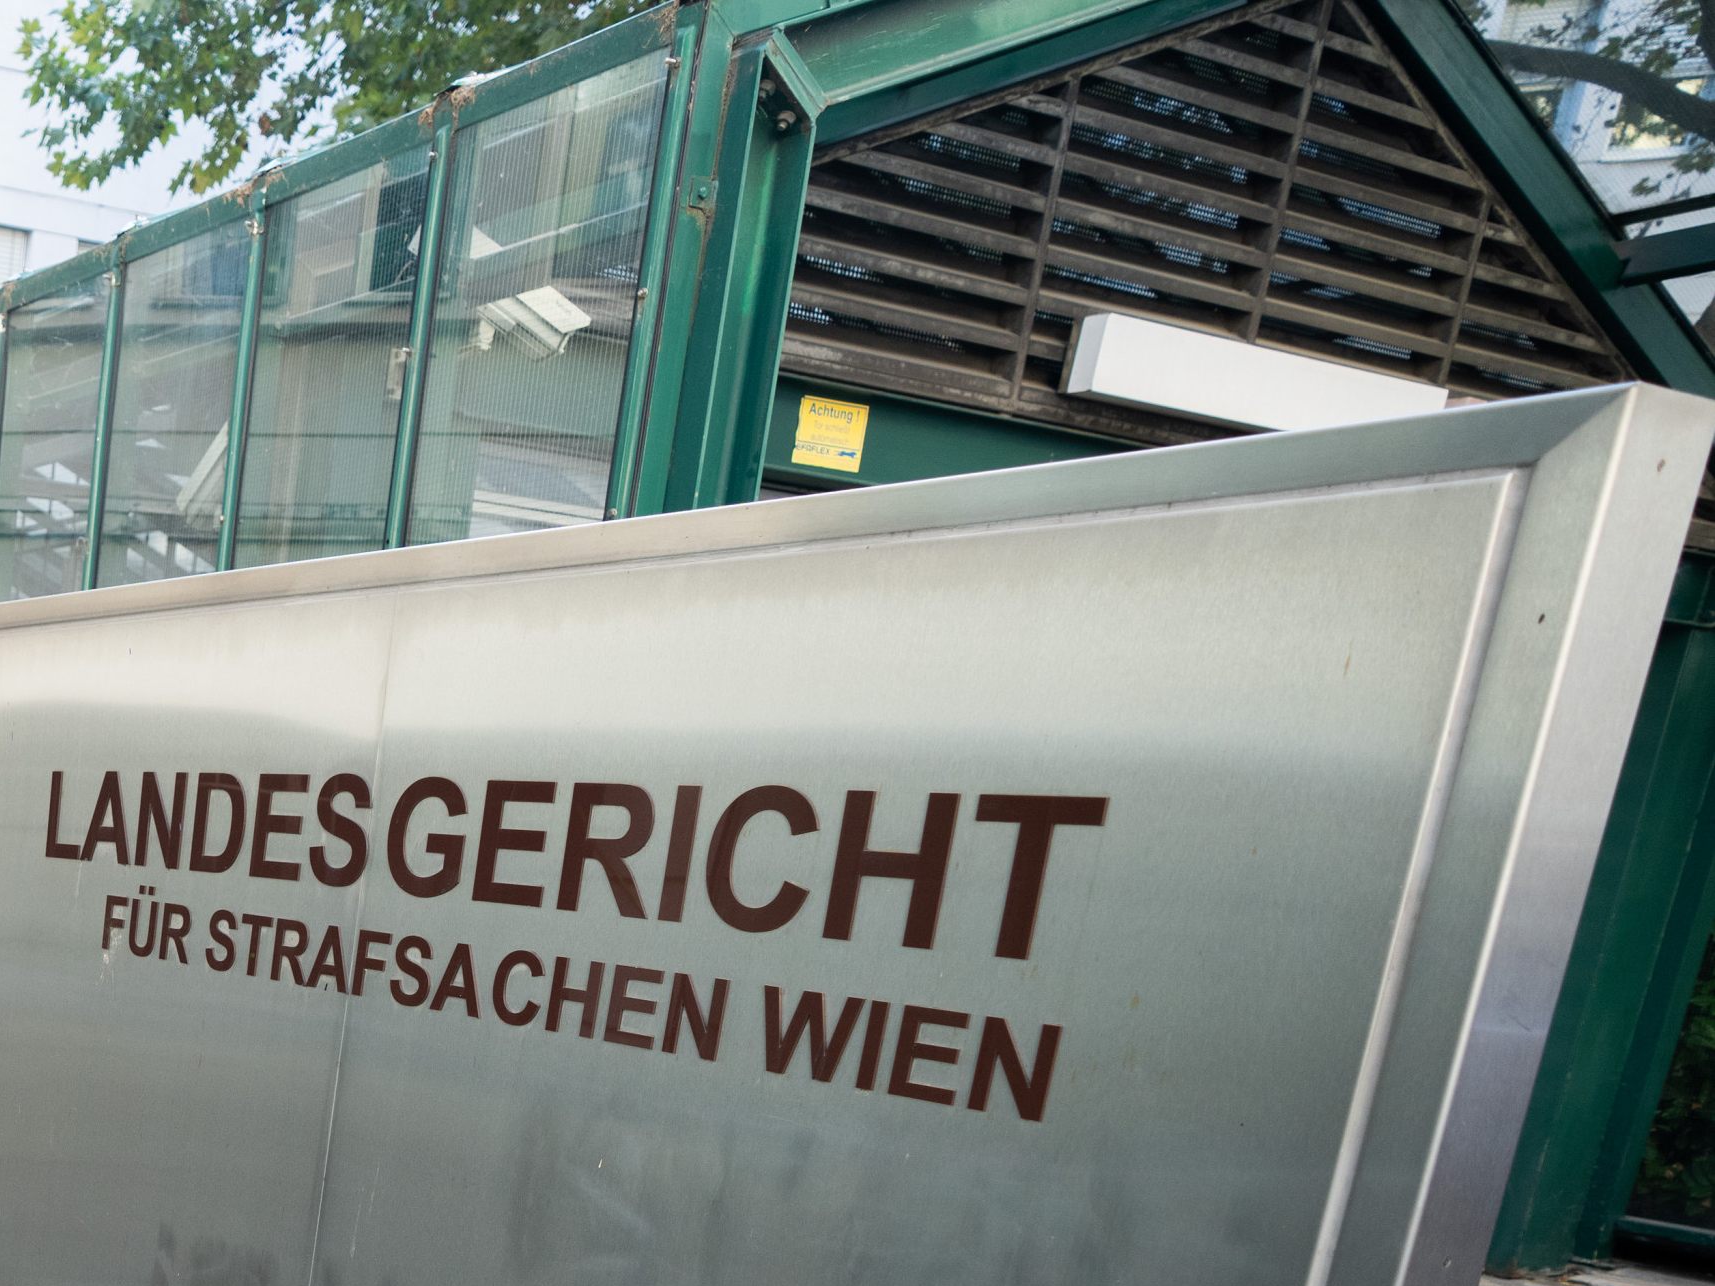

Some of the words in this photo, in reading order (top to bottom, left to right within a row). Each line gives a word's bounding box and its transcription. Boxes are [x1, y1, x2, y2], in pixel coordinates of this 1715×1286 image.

[809, 402, 854, 424] Achtung
[45, 771, 1109, 960] LANDESGERICHT
[101, 884, 191, 964] FÜR
[205, 909, 730, 1061] STRAFSACHEN
[764, 985, 1063, 1121] WIEN
